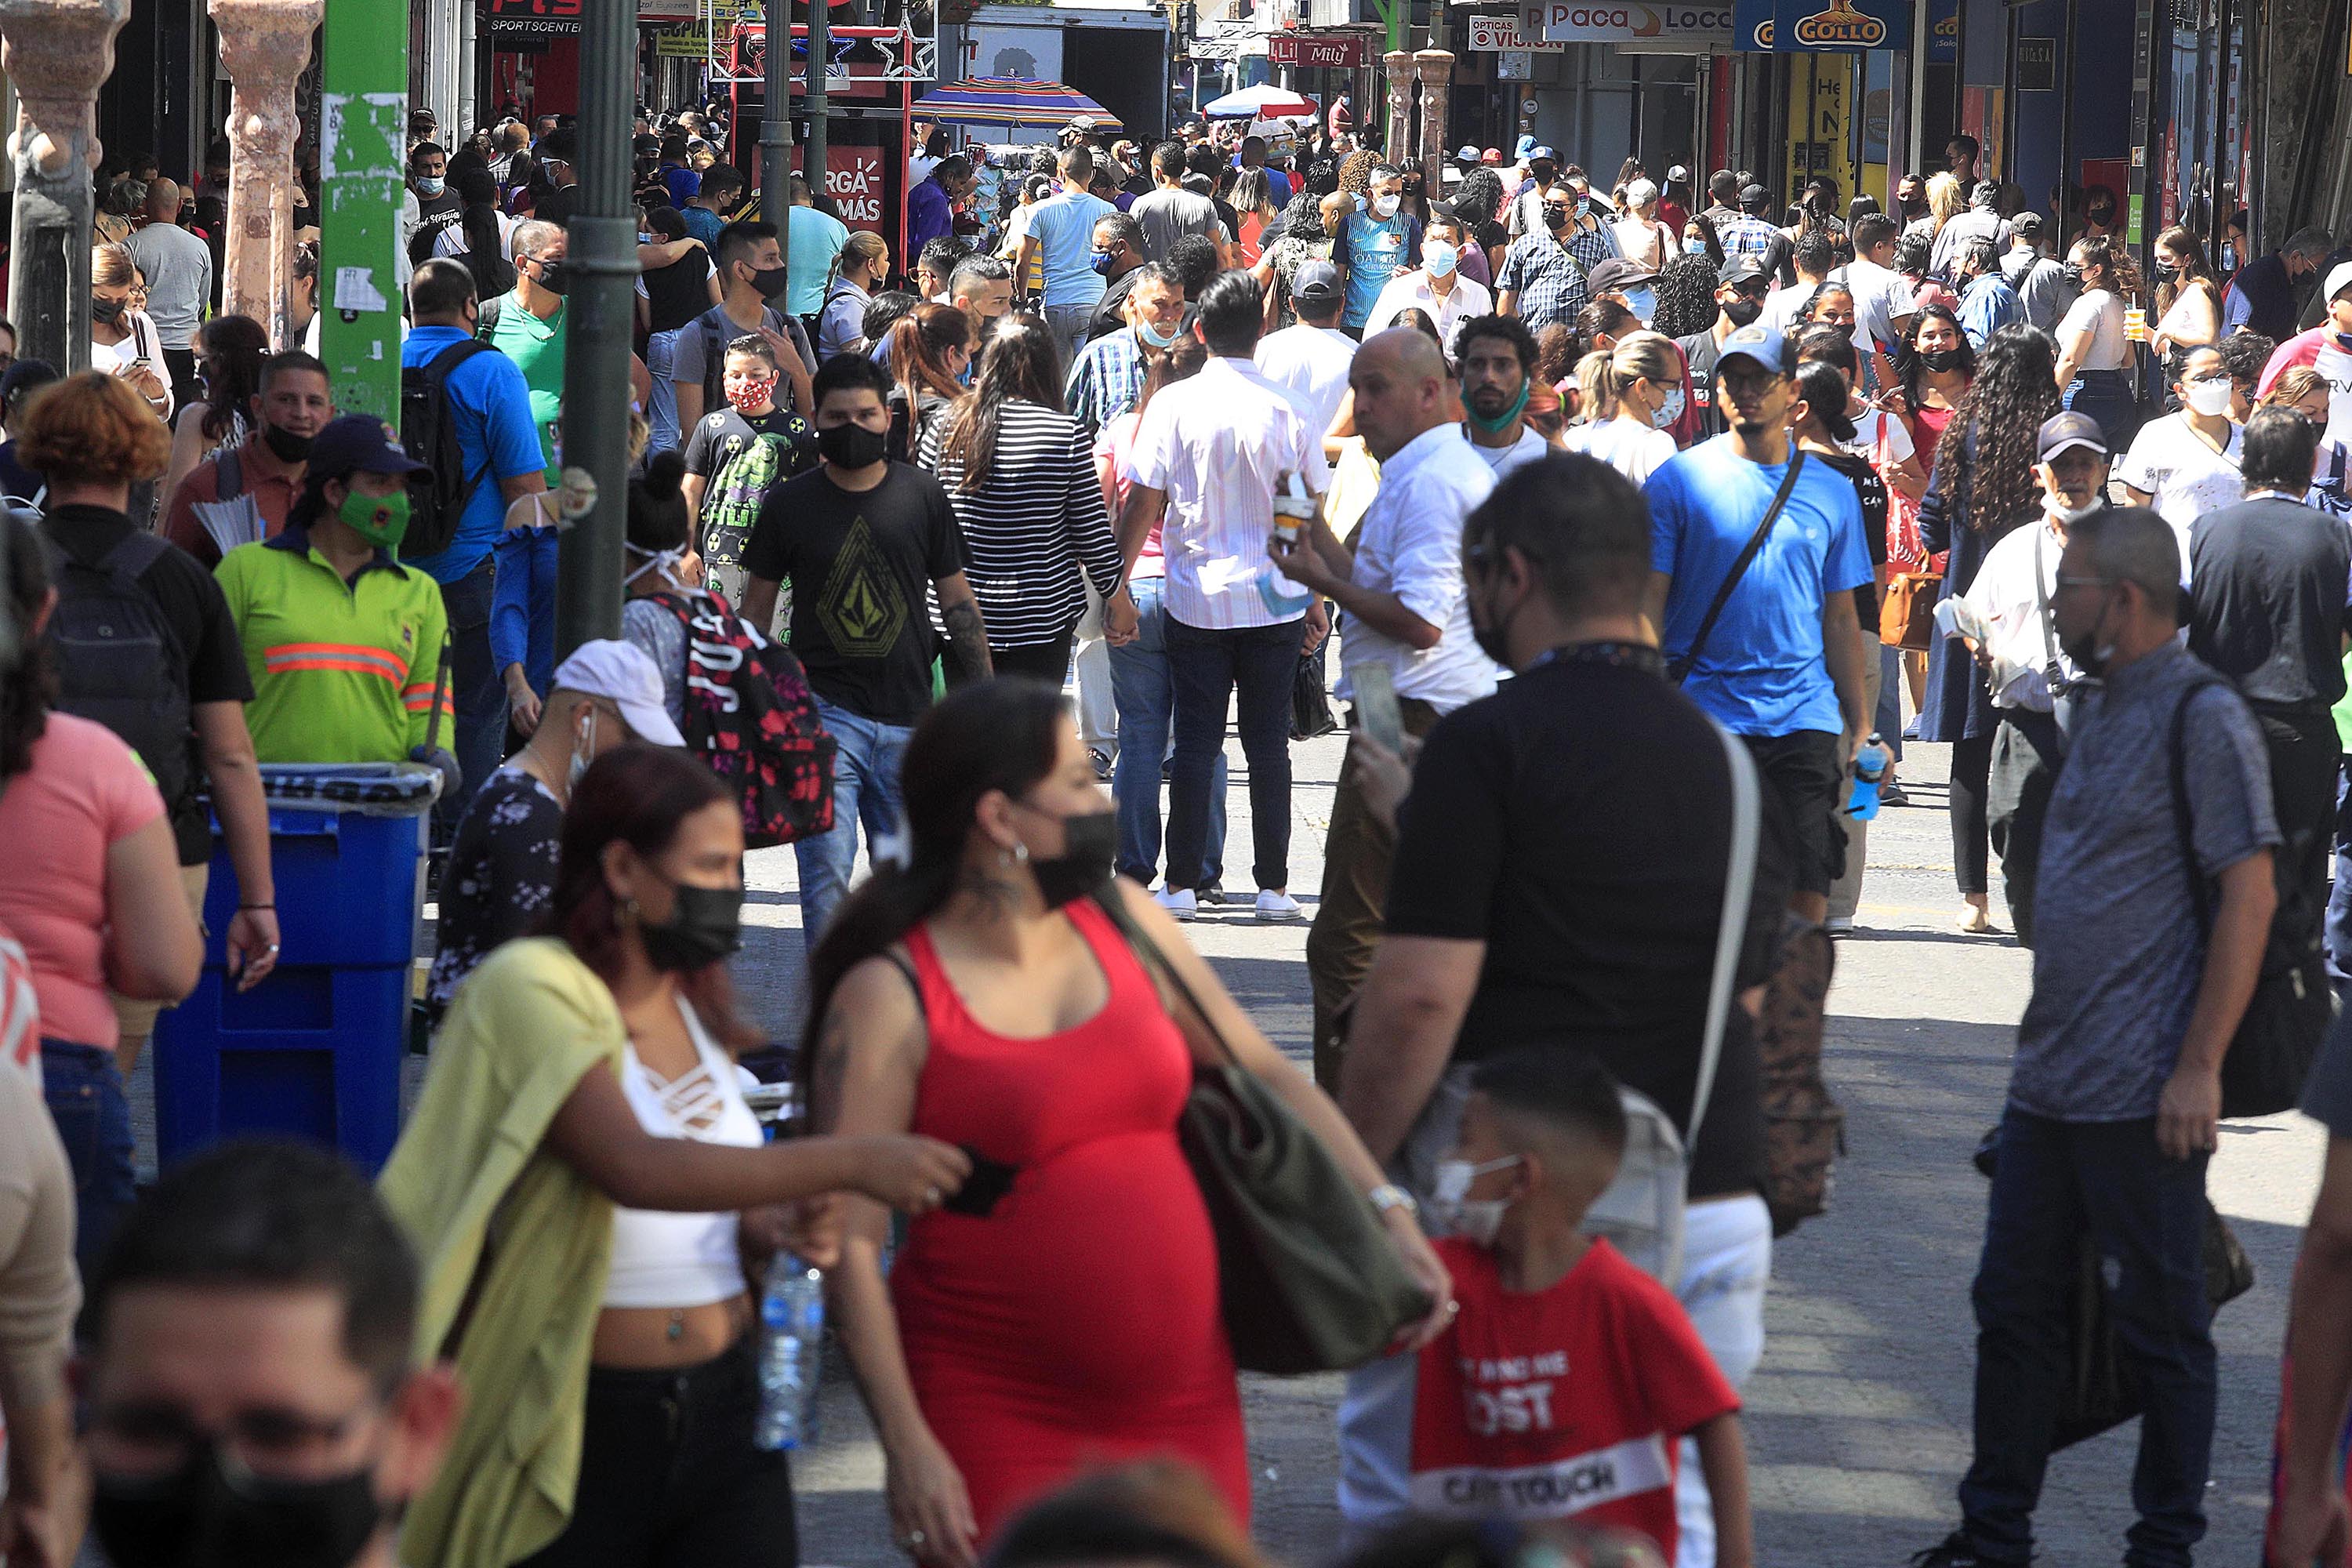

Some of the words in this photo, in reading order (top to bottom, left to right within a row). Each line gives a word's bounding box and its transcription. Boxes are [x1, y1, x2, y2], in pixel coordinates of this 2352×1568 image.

[1552, 5, 1628, 27] Paca
[1473, 21, 1513, 30] OPTICAS
[1802, 21, 1881, 39] GOLLO
[1311, 47, 1345, 65] Mily
[837, 195, 880, 221] MÁS
